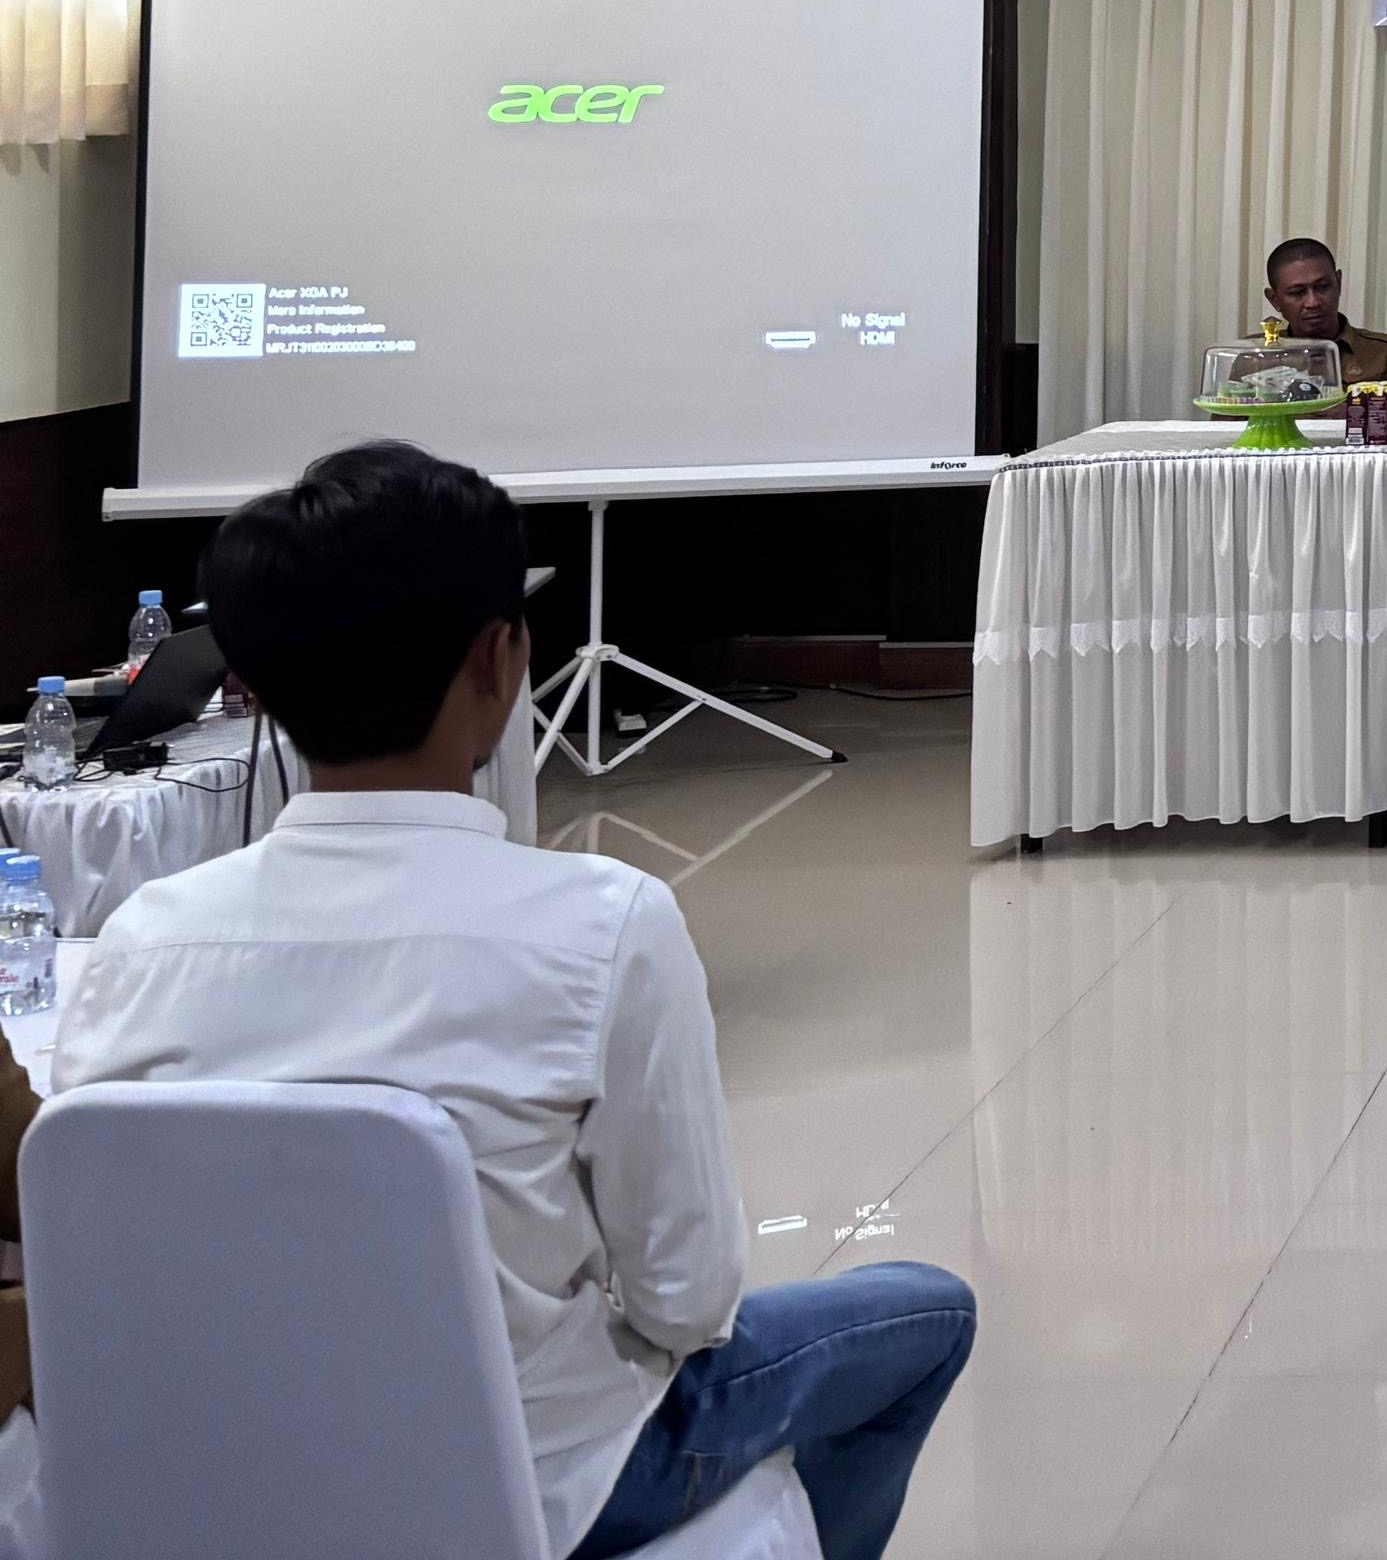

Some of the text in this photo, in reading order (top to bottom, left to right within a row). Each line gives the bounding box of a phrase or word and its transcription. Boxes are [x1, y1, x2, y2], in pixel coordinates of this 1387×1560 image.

[488, 84, 664, 124] acer
[268, 286, 349, 298] Acer XGA PJ
[267, 304, 365, 316] More Information
[841, 312, 905, 329] No Signal
[267, 322, 386, 335] Product Registration
[860, 331, 896, 345] HDMI
